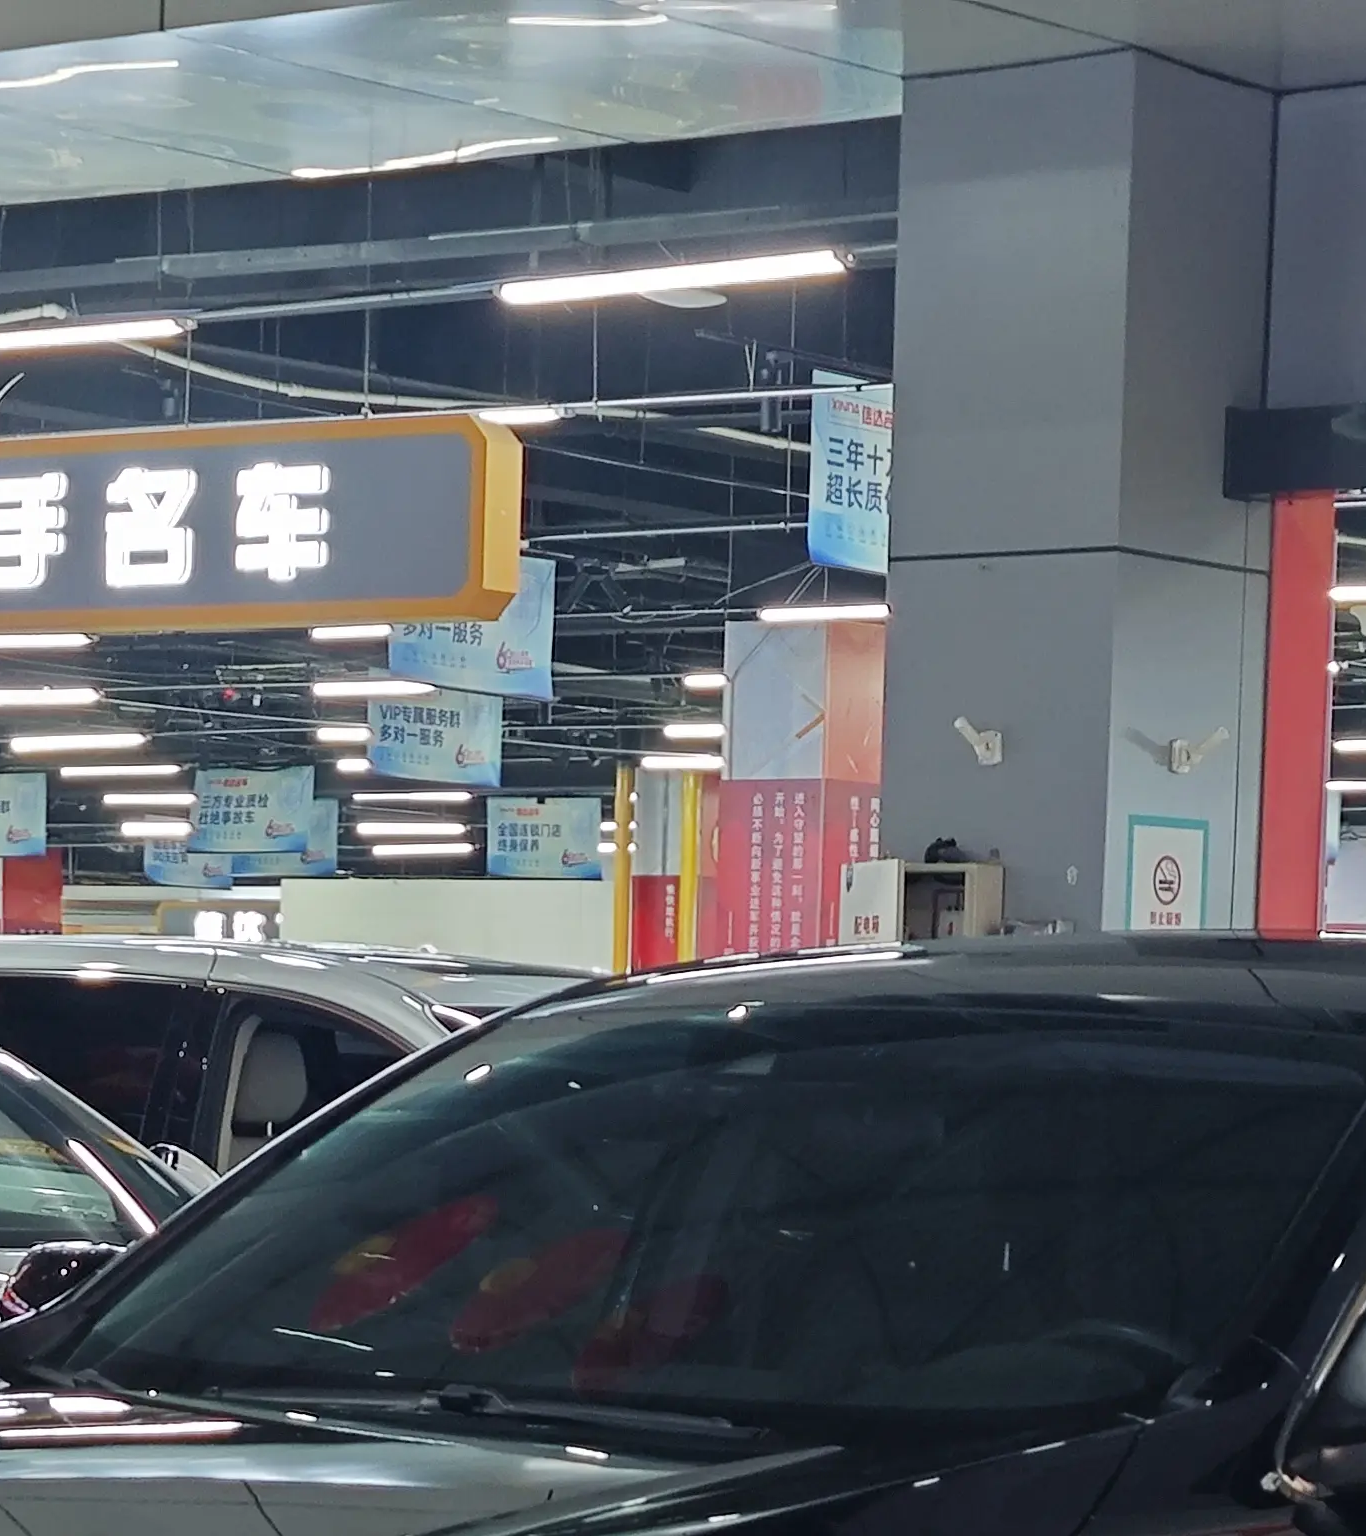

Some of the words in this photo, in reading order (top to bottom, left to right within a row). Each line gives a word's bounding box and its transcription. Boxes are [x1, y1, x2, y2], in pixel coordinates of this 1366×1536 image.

[403, 622, 484, 646] 多对一服务
[379, 705, 462, 729] VIP专属服务群
[379, 725, 445, 748] 多对一服务
[201, 792, 269, 809] 三方专业质检
[199, 808, 256, 825] 杜绝事故车
[497, 823, 562, 838] 全国连锁门店
